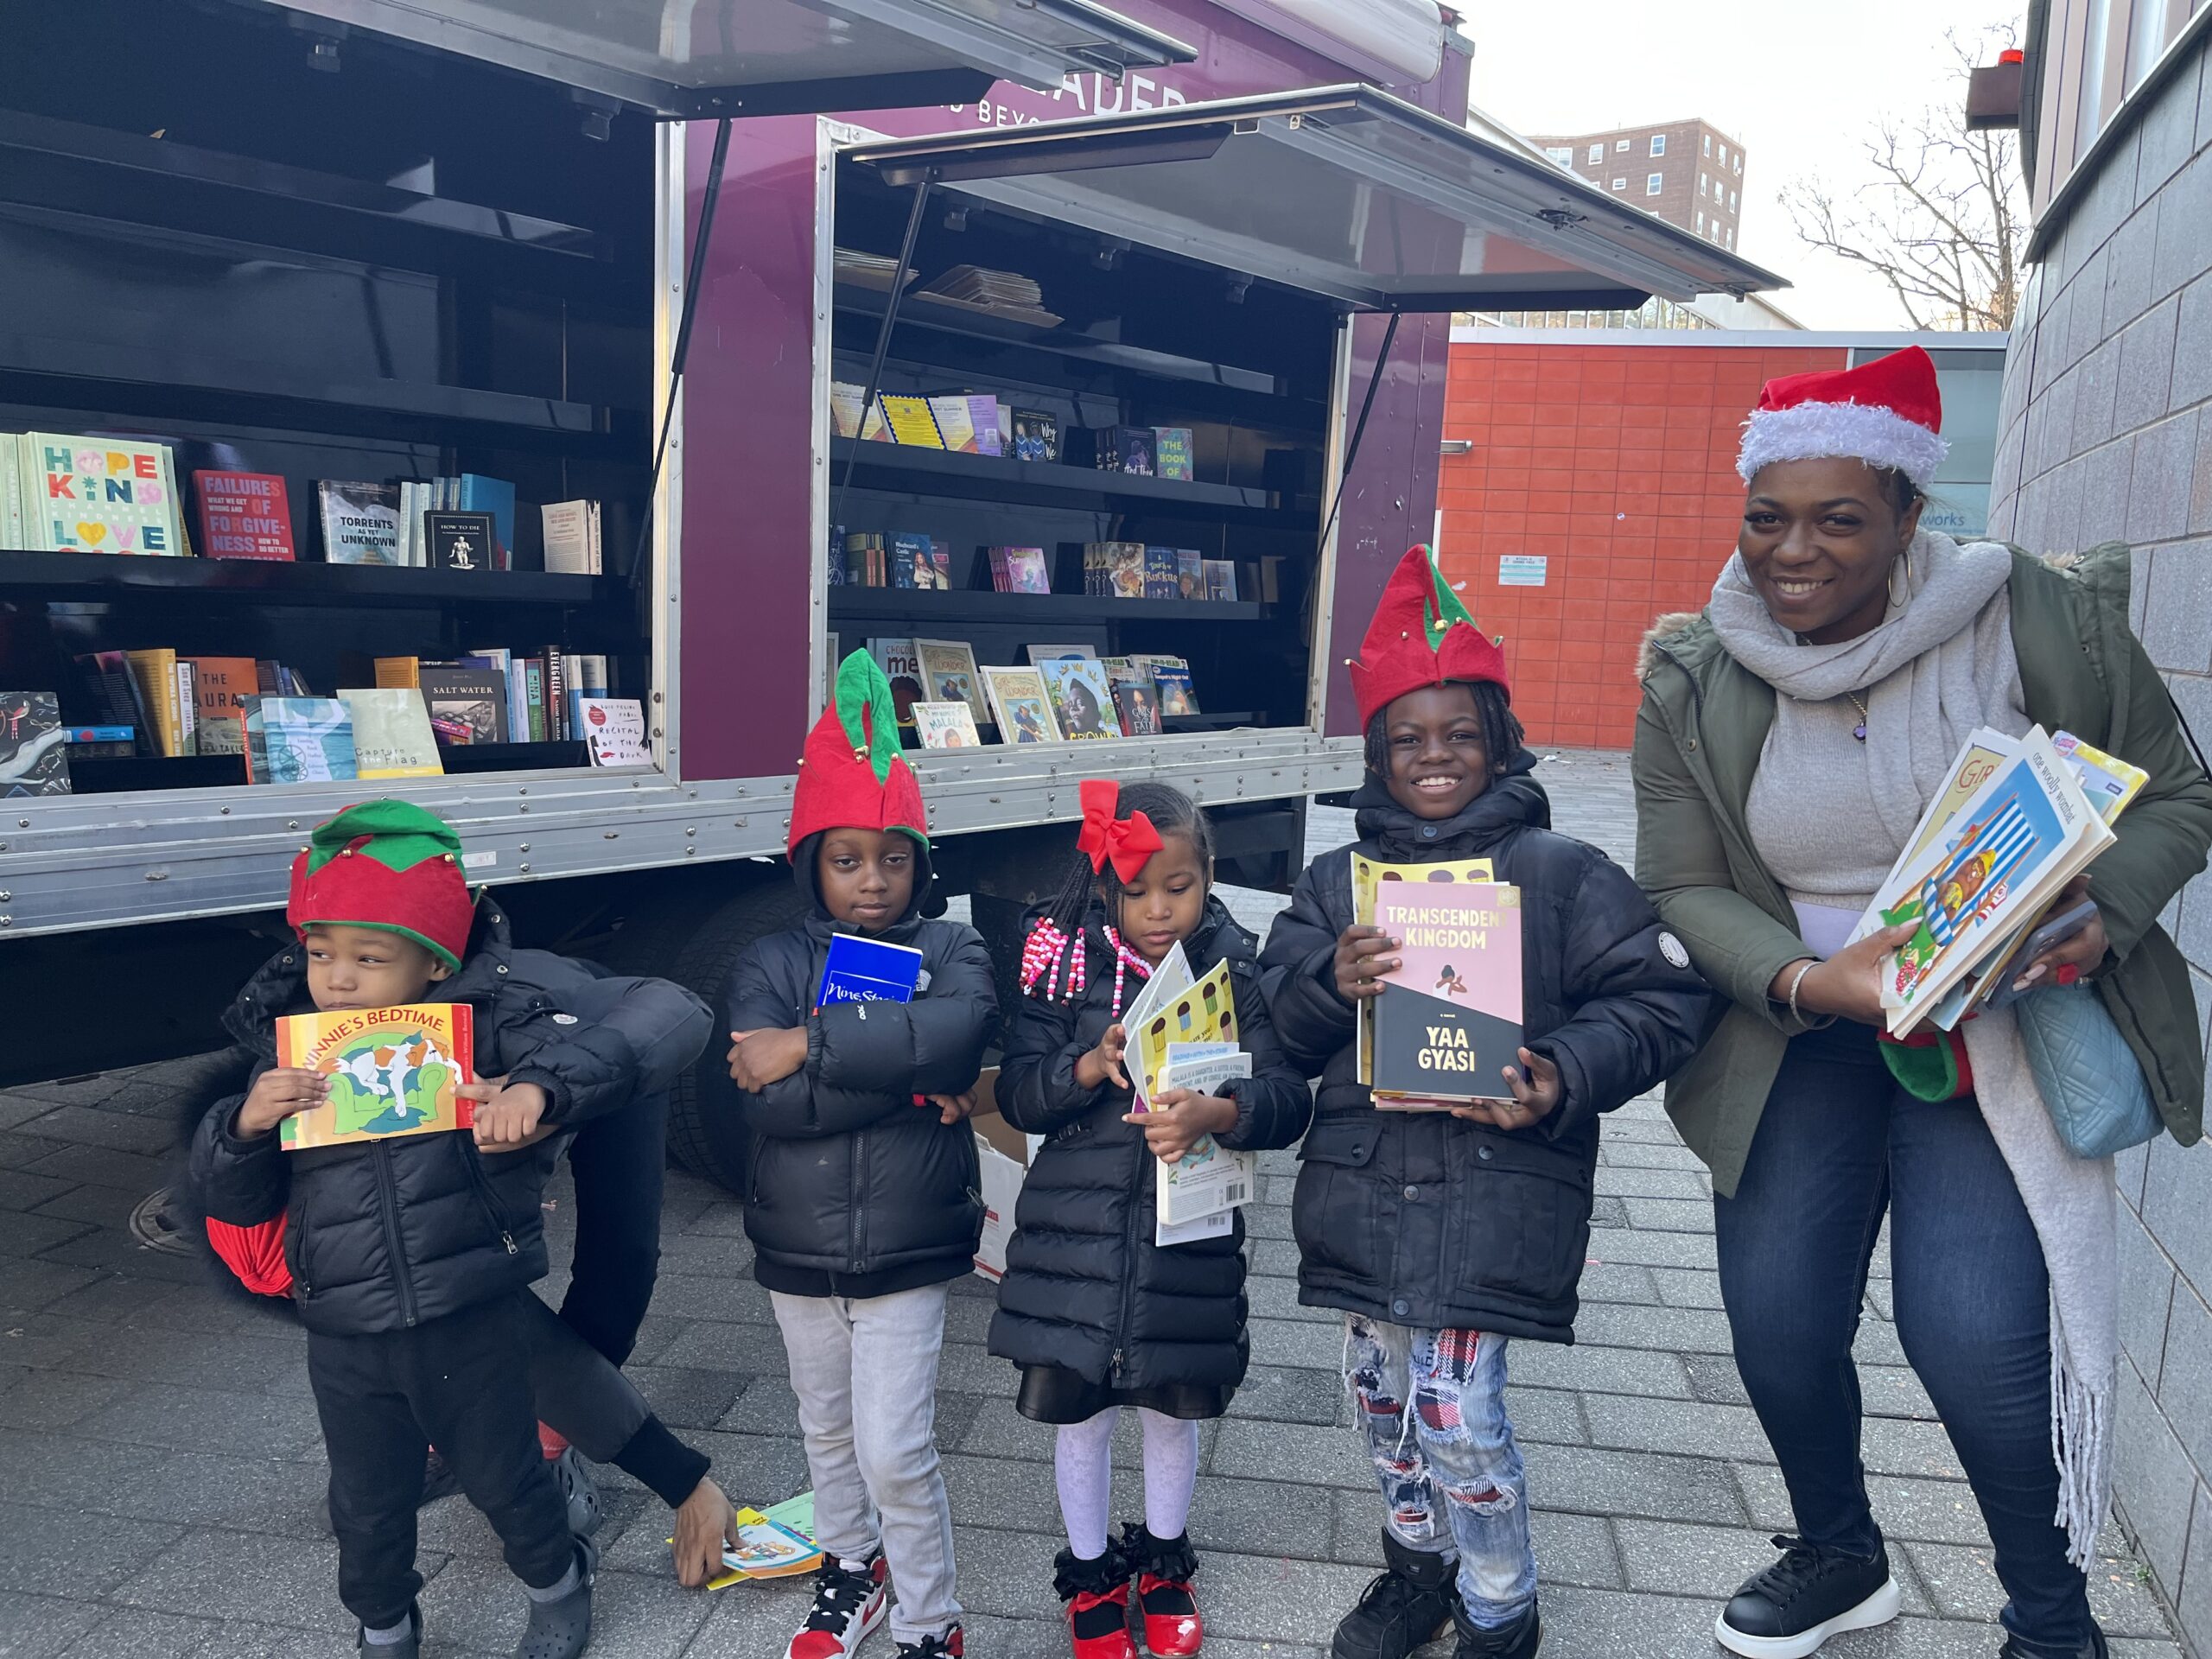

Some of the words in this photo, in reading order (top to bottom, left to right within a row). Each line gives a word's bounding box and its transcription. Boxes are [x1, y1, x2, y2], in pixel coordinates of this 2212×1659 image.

[1028, 73, 1186, 116] ADER
[1041, 422, 1057, 442] Why
[1046, 443, 1056, 460] We
[1163, 441, 1183, 450] THE
[45, 447, 157, 479] HOPE
[1160, 454, 1186, 463] BOOK
[1166, 467, 1180, 477] OF
[204, 477, 281, 498] FAILURES
[50, 501, 162, 516] CHANNEL
[251, 498, 271, 515] OF
[52, 511, 162, 525] KINDNESS
[209, 515, 285, 535] FORGIVE-
[340, 517, 394, 529] TORRENTS
[1922, 512, 1965, 526] works
[212, 535, 256, 552] NESS
[340, 534, 396, 547] UNKNOWN
[1144, 571, 1178, 584] Ruckus
[887, 657, 919, 674] me
[202, 674, 227, 684] THE
[550, 652, 562, 696] EVERGREEN
[434, 686, 458, 695] SALT
[460, 686, 494, 695] WATER
[199, 693, 246, 707] URA
[930, 716, 963, 731] MALALA
[1134, 721, 1156, 734] FATE
[355, 747, 404, 757] Capture
[385, 755, 418, 766] Flag
[1958, 760, 2000, 789] GIR
[2032, 752, 2044, 770] one
[2041, 768, 2060, 795] woolly
[2057, 791, 2076, 825] wombat
[1405, 927, 1486, 950] KINGDOM
[366, 1009, 445, 1032] BEDTIME
[1426, 1027, 1469, 1049] YAA
[1418, 1049, 1476, 1071] GYASI
